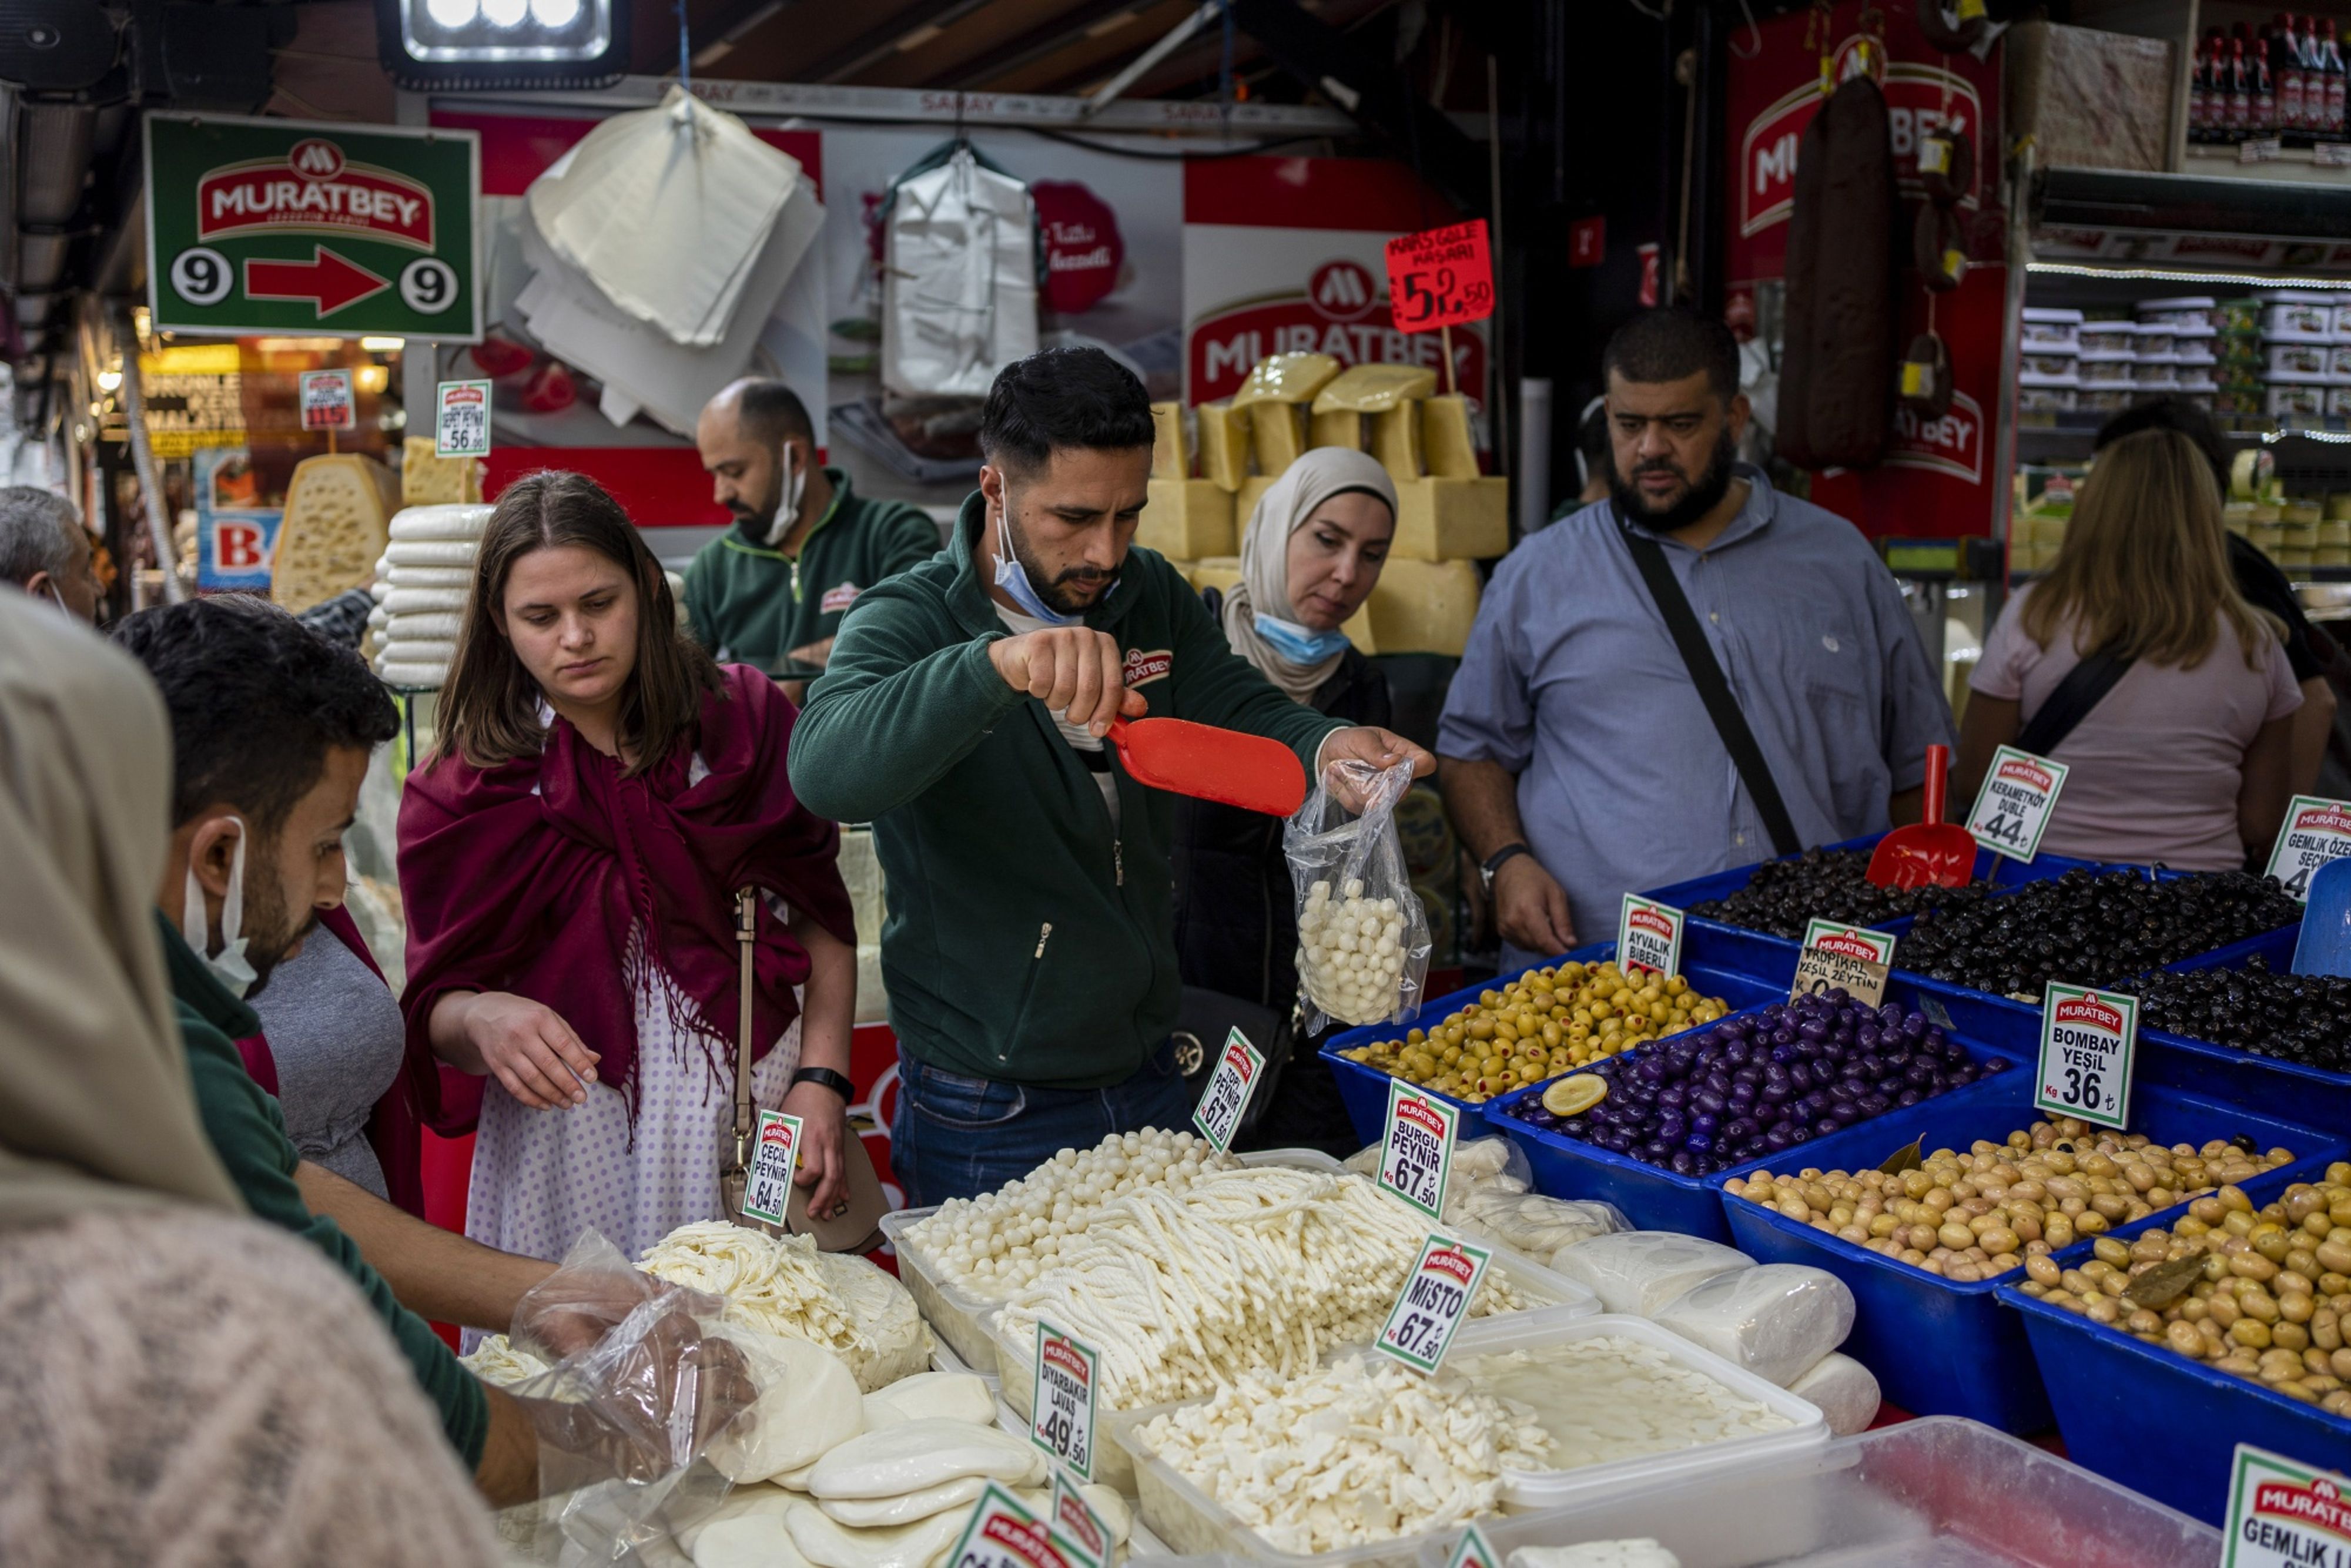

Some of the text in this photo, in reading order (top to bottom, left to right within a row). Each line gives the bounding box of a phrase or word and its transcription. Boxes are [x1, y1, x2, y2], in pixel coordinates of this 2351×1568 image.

[212, 180, 421, 227] MURATBEY
[183, 256, 447, 303] 9 9
[2002, 764, 2051, 786] MURATBEY
[1998, 798, 2027, 817] DUBLE
[1984, 813, 2024, 845] 44
[2300, 815, 2351, 829] MURATBE
[2329, 836, 2351, 857] ÖZE
[1631, 913, 1672, 934] MURATBEY
[1629, 930, 1670, 957] AYVALIK
[1819, 940, 1876, 961] MURATBEY
[2059, 1006, 2119, 1027] MURATBEY
[2052, 1027, 2121, 1055] BOMBAY
[2045, 1084, 2058, 1098] Kg
[2062, 1068, 2101, 1110] 36
[1399, 1103, 1444, 1131] MURATBEY
[1398, 1120, 1439, 1152] BURGU
[1384, 1170, 1394, 1184] Kg
[1427, 1255, 1472, 1278] MURATBEY
[1046, 1345, 1086, 1377] MURATBEY
[2262, 1489, 2351, 1530] MURATB
